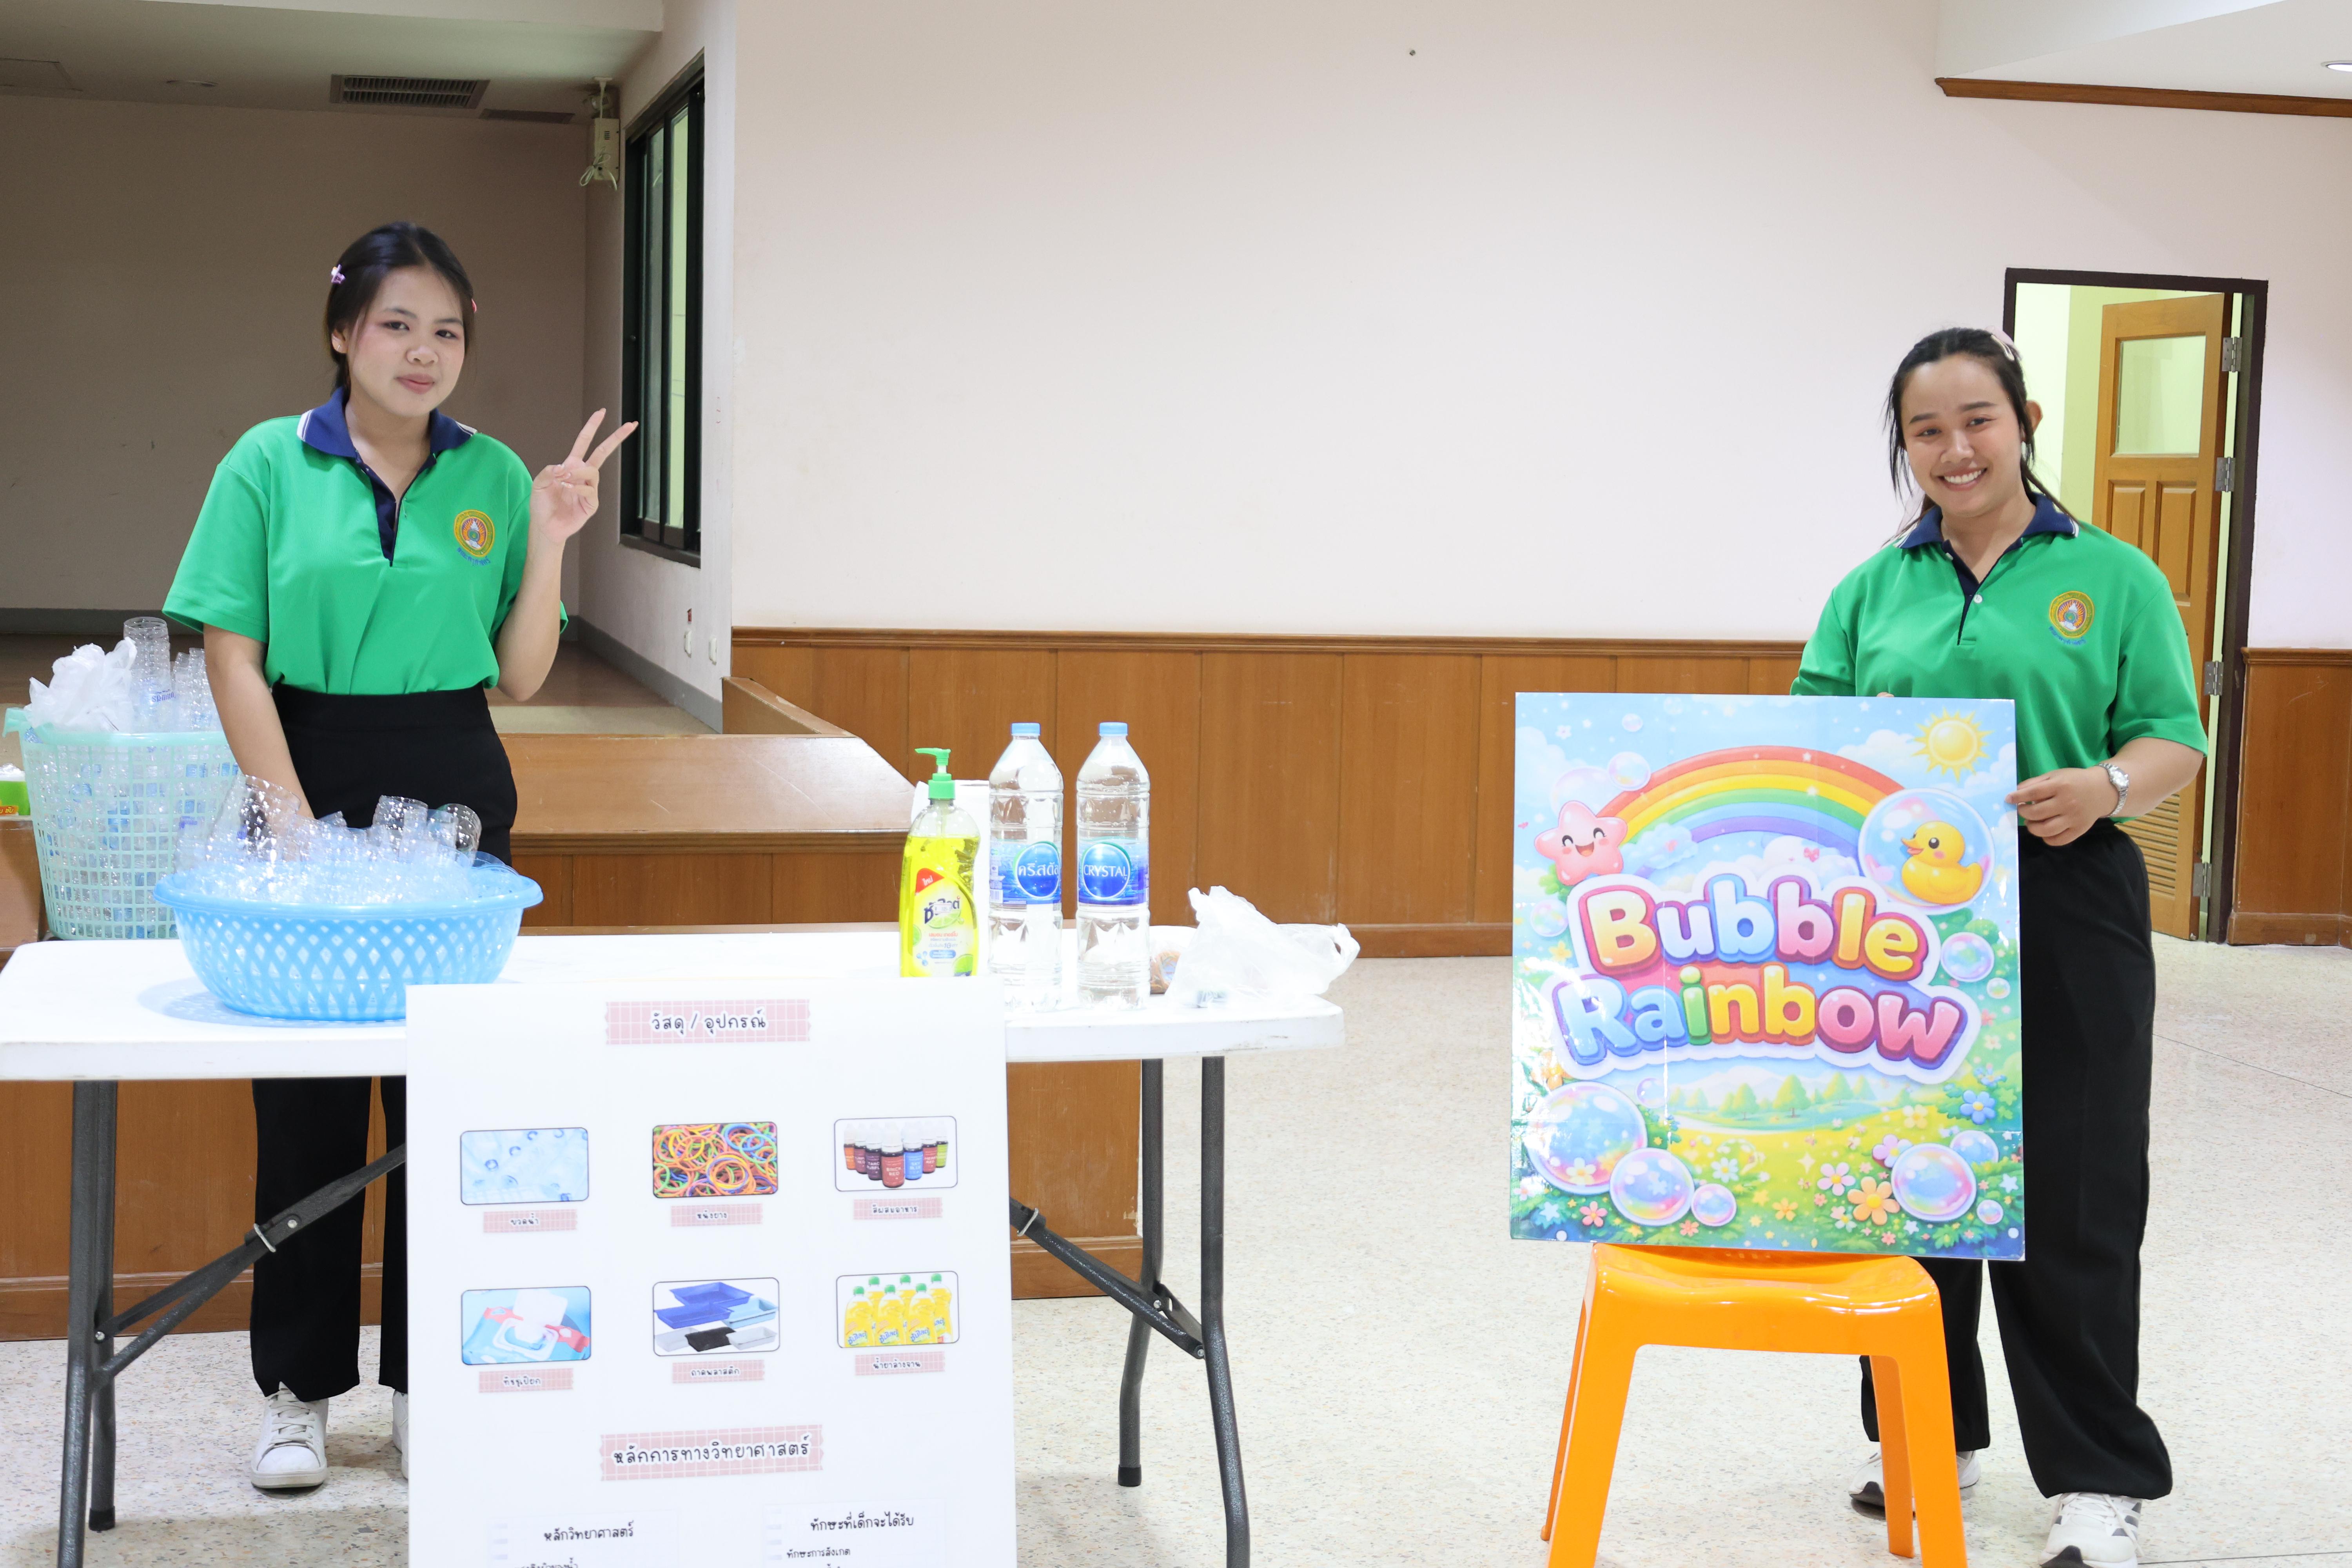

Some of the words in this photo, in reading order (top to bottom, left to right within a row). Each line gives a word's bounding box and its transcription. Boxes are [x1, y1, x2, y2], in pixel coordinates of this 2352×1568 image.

[1083, 864, 1127, 877] CRYSTAL
[1584, 873, 1929, 981] Bubble
[652, 1013, 684, 1035] วัสดุ
[691, 1013, 698, 1029] /
[706, 1009, 766, 1035] อุปกรณ์
[1553, 963, 1968, 1070] Rainbow
[873, 1204, 917, 1213] สีผสมอาหาร
[691, 1366, 740, 1376] ถาดพลาสติก
[873, 1357, 921, 1369] น้ำยาล้างจาน
[613, 1435, 809, 1463] หลักการทางวิทยาศาสตร์
[544, 1520, 634, 1541] หลักวิทยาศาสตร์
[811, 1511, 914, 1531] ทักษะที่เด็กจะได้รับ
[787, 1546, 851, 1559] ทักษะการสังเกต
